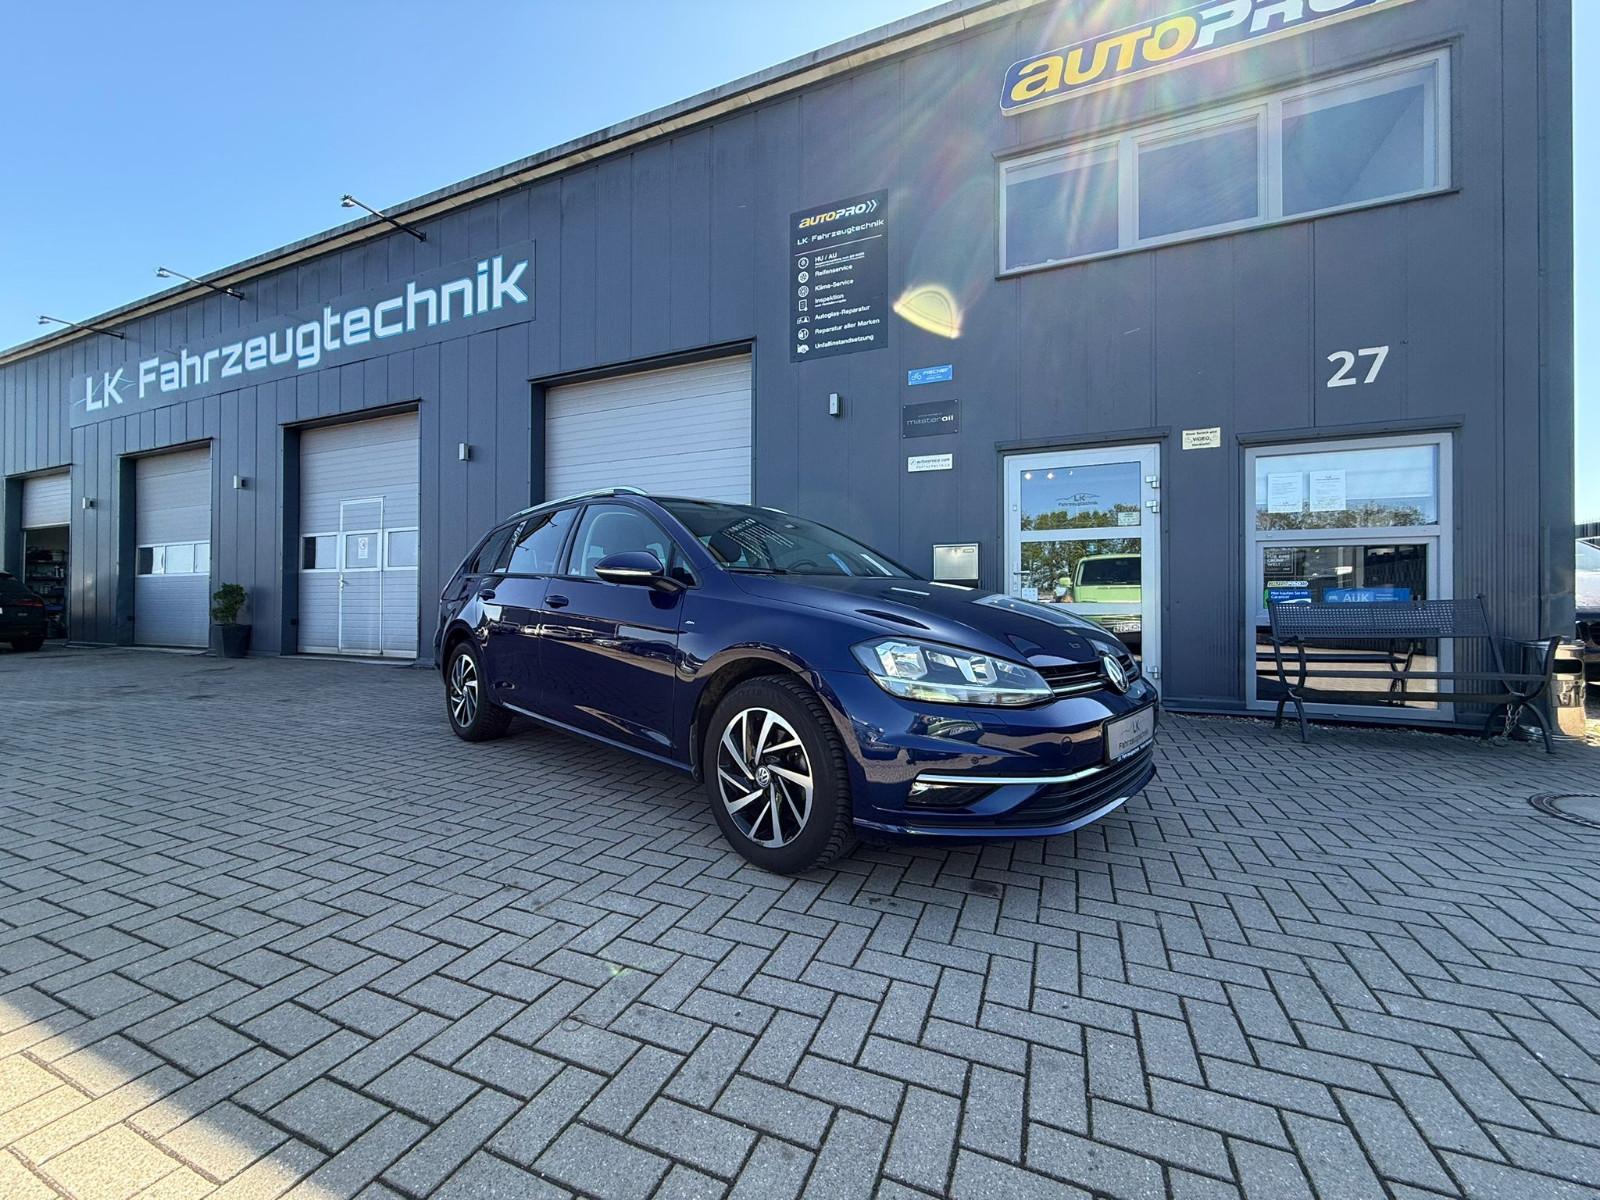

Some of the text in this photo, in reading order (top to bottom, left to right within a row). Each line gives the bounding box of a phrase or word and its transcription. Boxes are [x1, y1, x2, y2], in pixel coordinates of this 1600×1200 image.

[797, 219, 885, 246] LK Fahrzeugtechnik
[815, 264, 853, 277] Reifenservice
[815, 279, 854, 292] Klima-Service
[815, 293, 845, 304] Inspektion
[815, 305, 871, 320] Autoglas-Reparatur
[86, 255, 529, 412] LK Fahrzeugtechnik
[815, 325, 843, 335] Reparatur
[857, 318, 880, 327] Marken
[815, 334, 875, 350] Unfallinstandsetzung
[1325, 345, 1389, 389] 27
[1343, 593, 1369, 602] AUK
